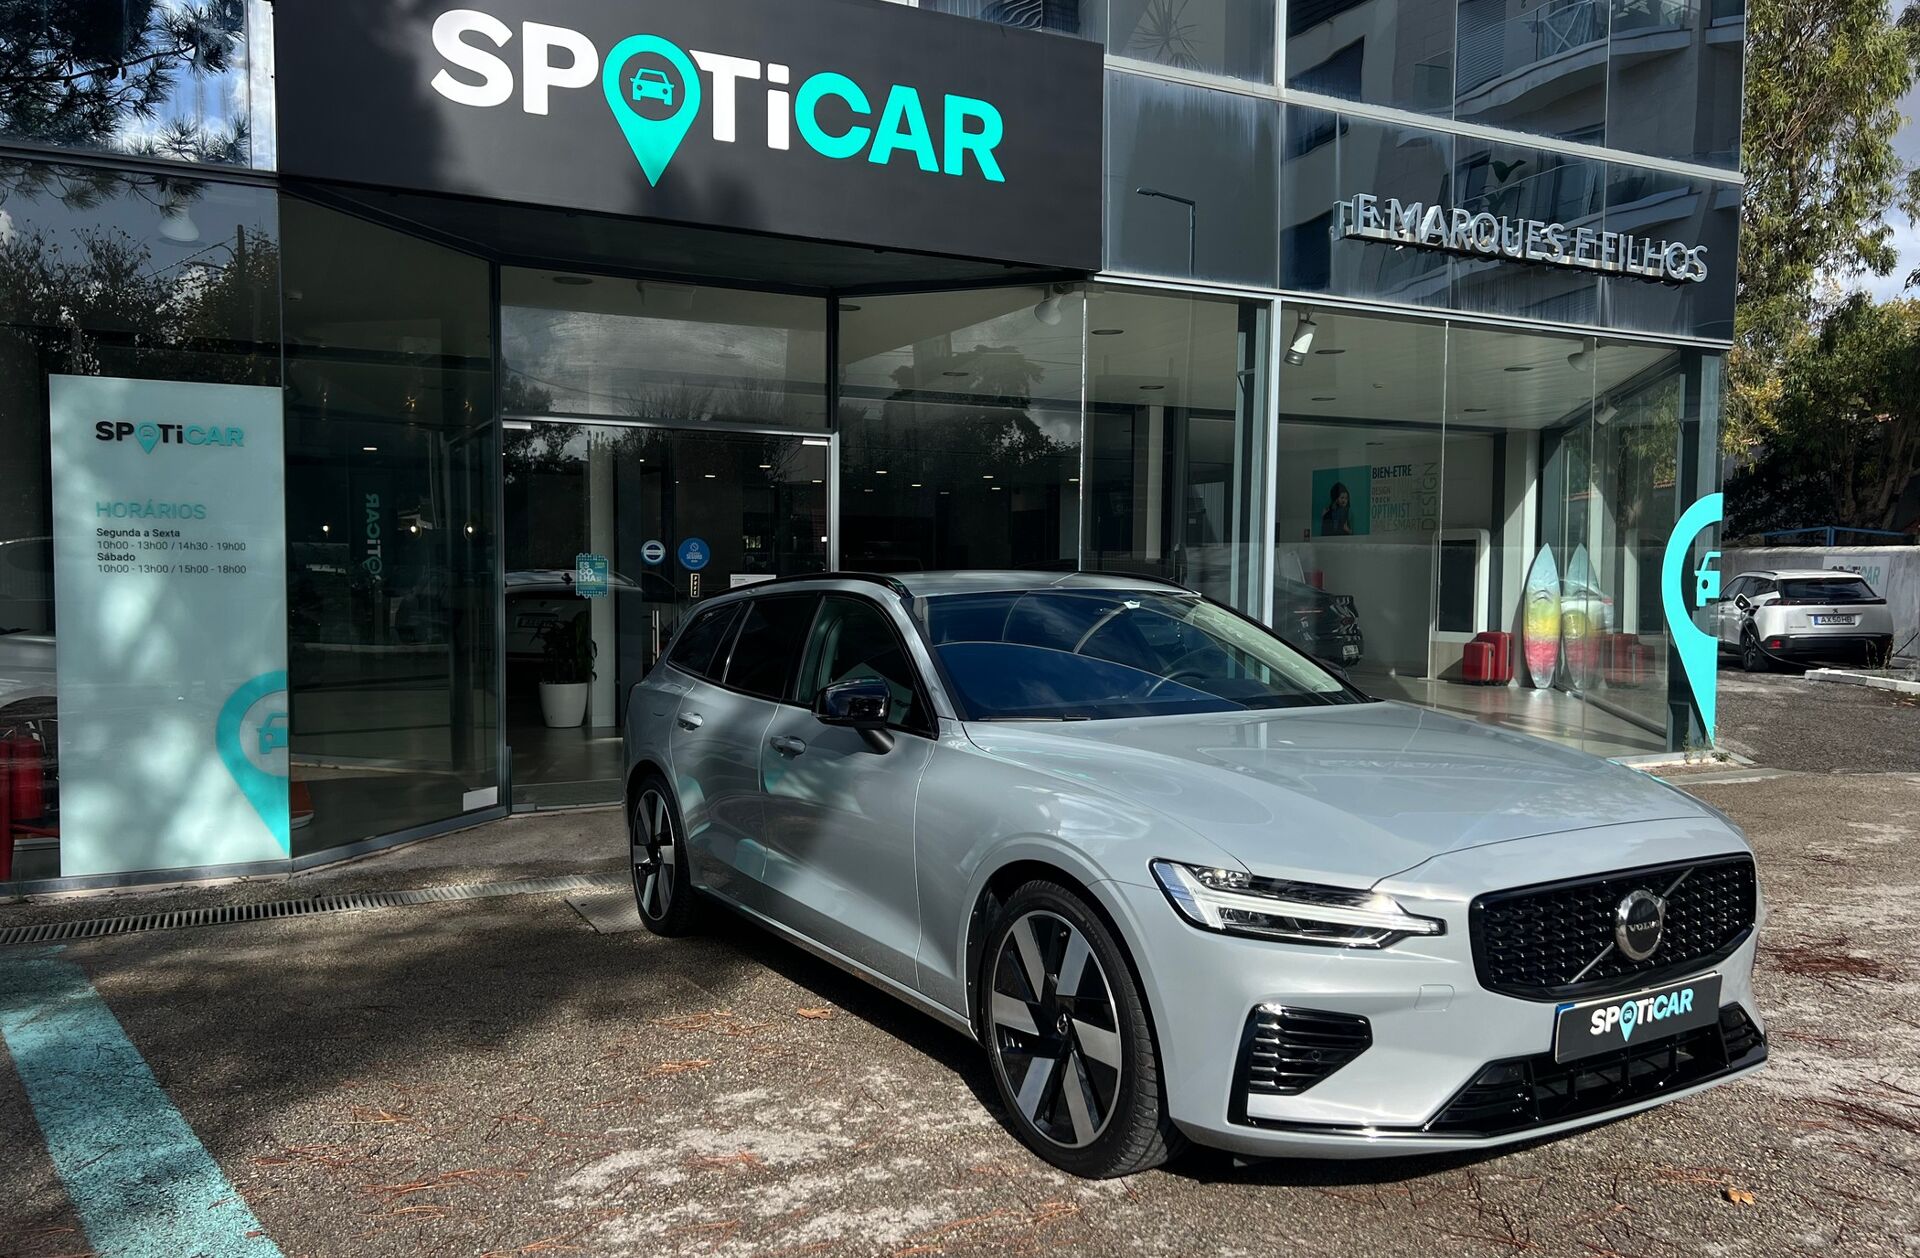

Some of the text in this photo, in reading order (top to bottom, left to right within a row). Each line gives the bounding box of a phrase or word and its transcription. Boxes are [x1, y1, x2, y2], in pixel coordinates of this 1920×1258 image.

[1384, 197, 1565, 263] MARQUES
[1601, 231, 1709, 283] FILHOS
[1422, 462, 1438, 531] DESIGN
[96, 499, 207, 520] HORÁRIOS
[1372, 503, 1411, 520] OPTIMIST
[96, 528, 141, 539] Segunda
[152, 529, 181, 538] Sexta
[97, 541, 128, 550] 10h00
[138, 541, 168, 550] 13h00
[179, 542, 208, 551] 14h30
[217, 542, 246, 551] 19h00
[97, 552, 136, 562] Sábado
[98, 564, 129, 574] 10h00
[138, 564, 169, 574] 13h00
[179, 565, 209, 574] 15h00
[217, 565, 247, 574] 18h00
